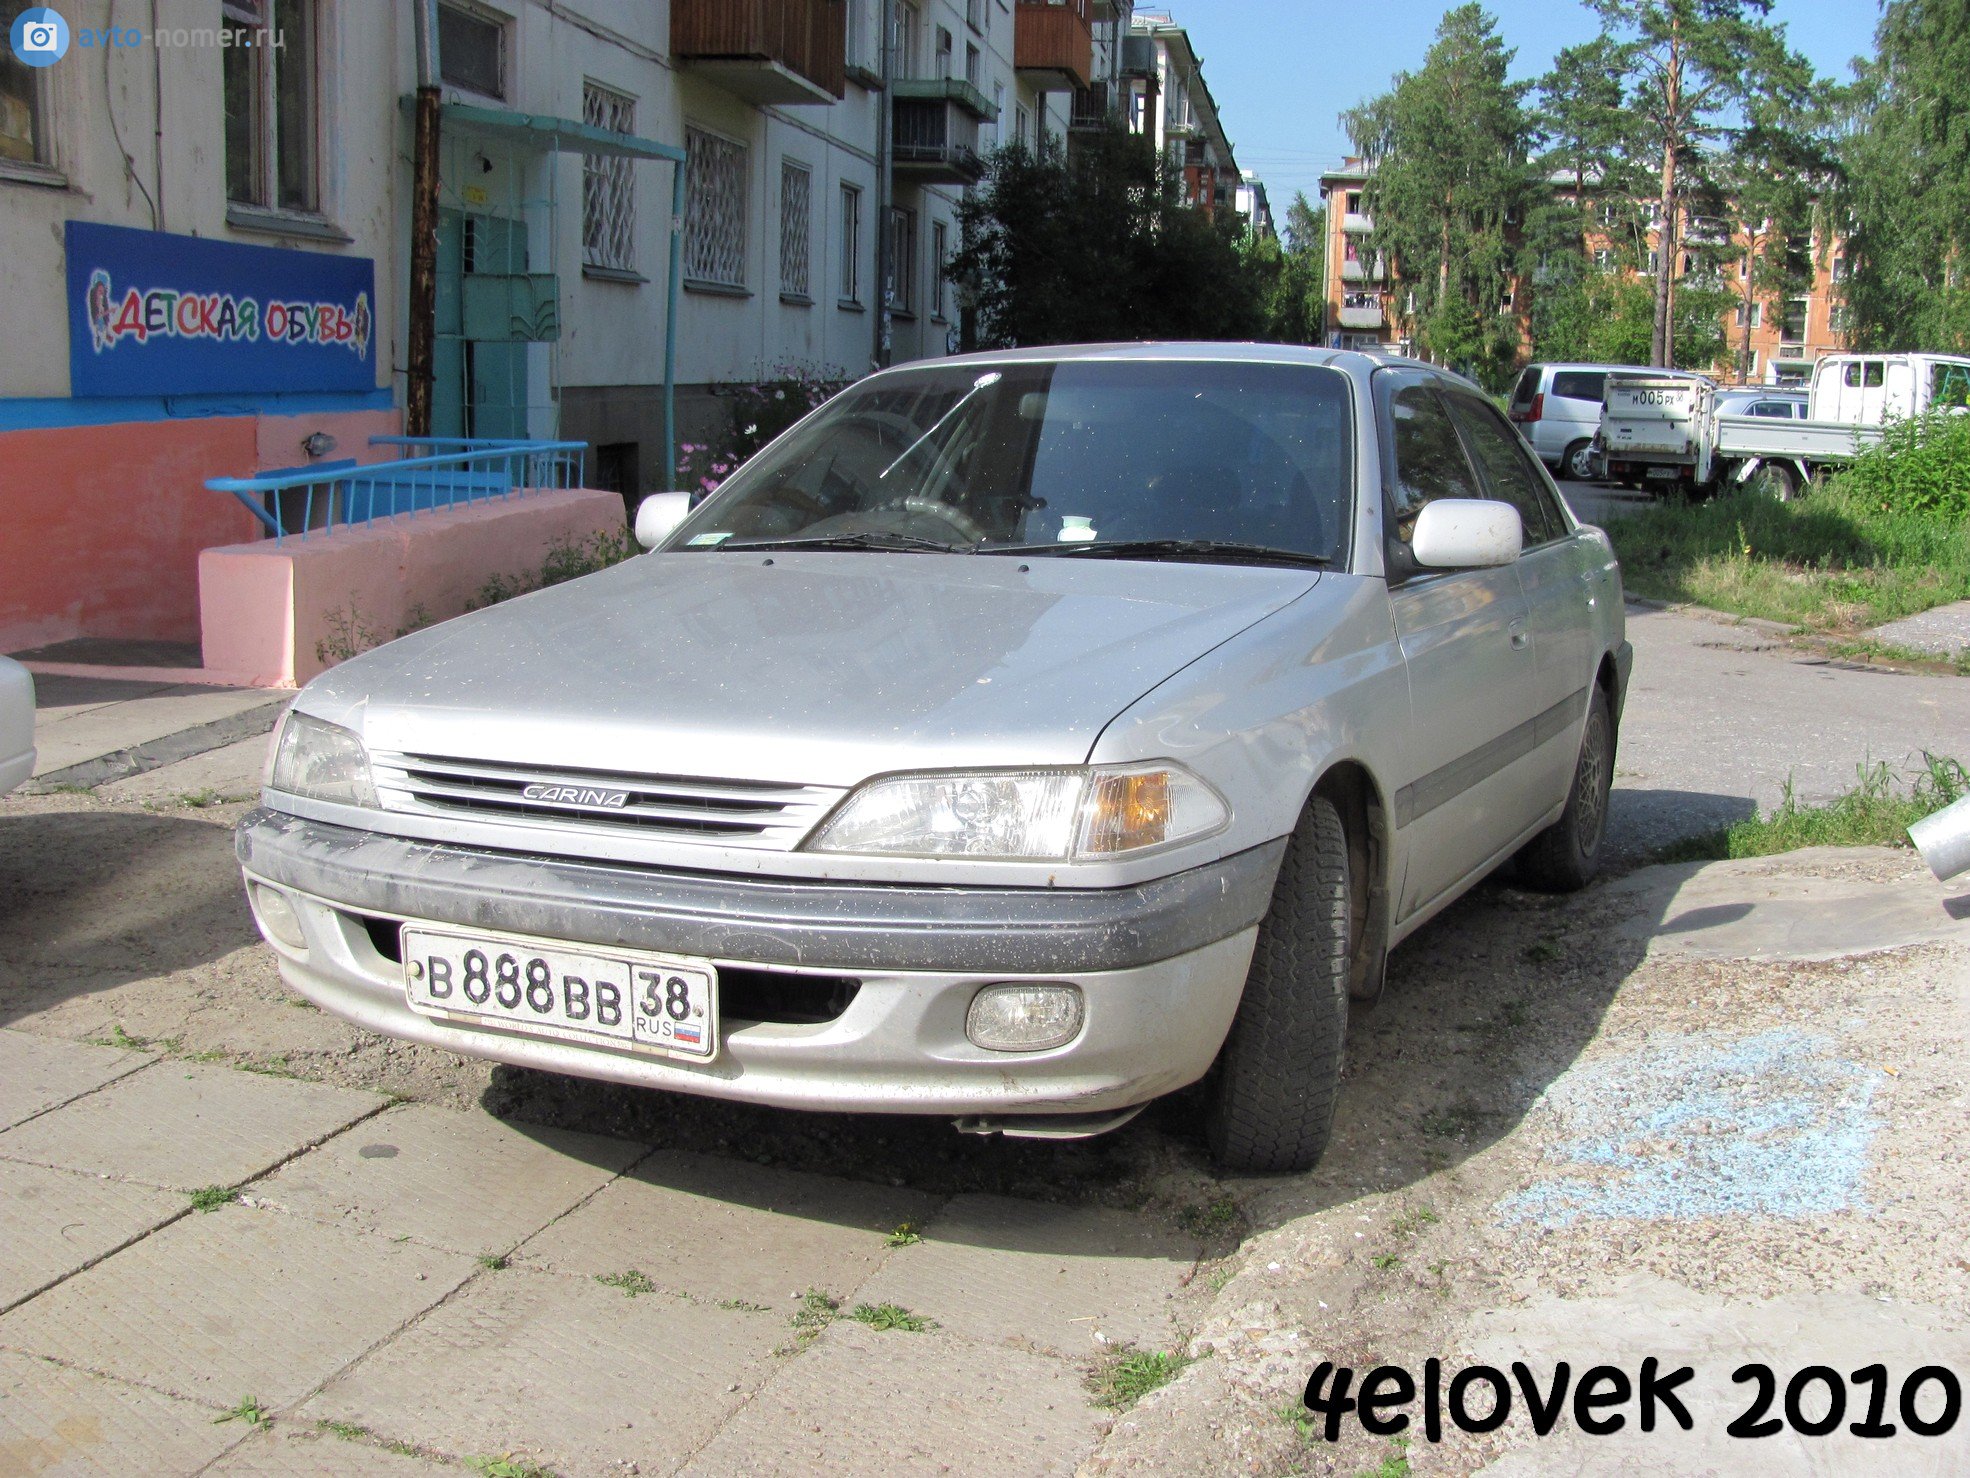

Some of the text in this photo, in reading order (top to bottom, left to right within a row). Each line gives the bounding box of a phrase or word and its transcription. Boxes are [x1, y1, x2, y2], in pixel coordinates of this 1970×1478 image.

[112, 291, 353, 341] ДЕТСКАЯ ОБУВЬ
[523, 785, 627, 807] CARINA
[638, 970, 691, 1022] 38
[635, 1016, 672, 1038] RUS
